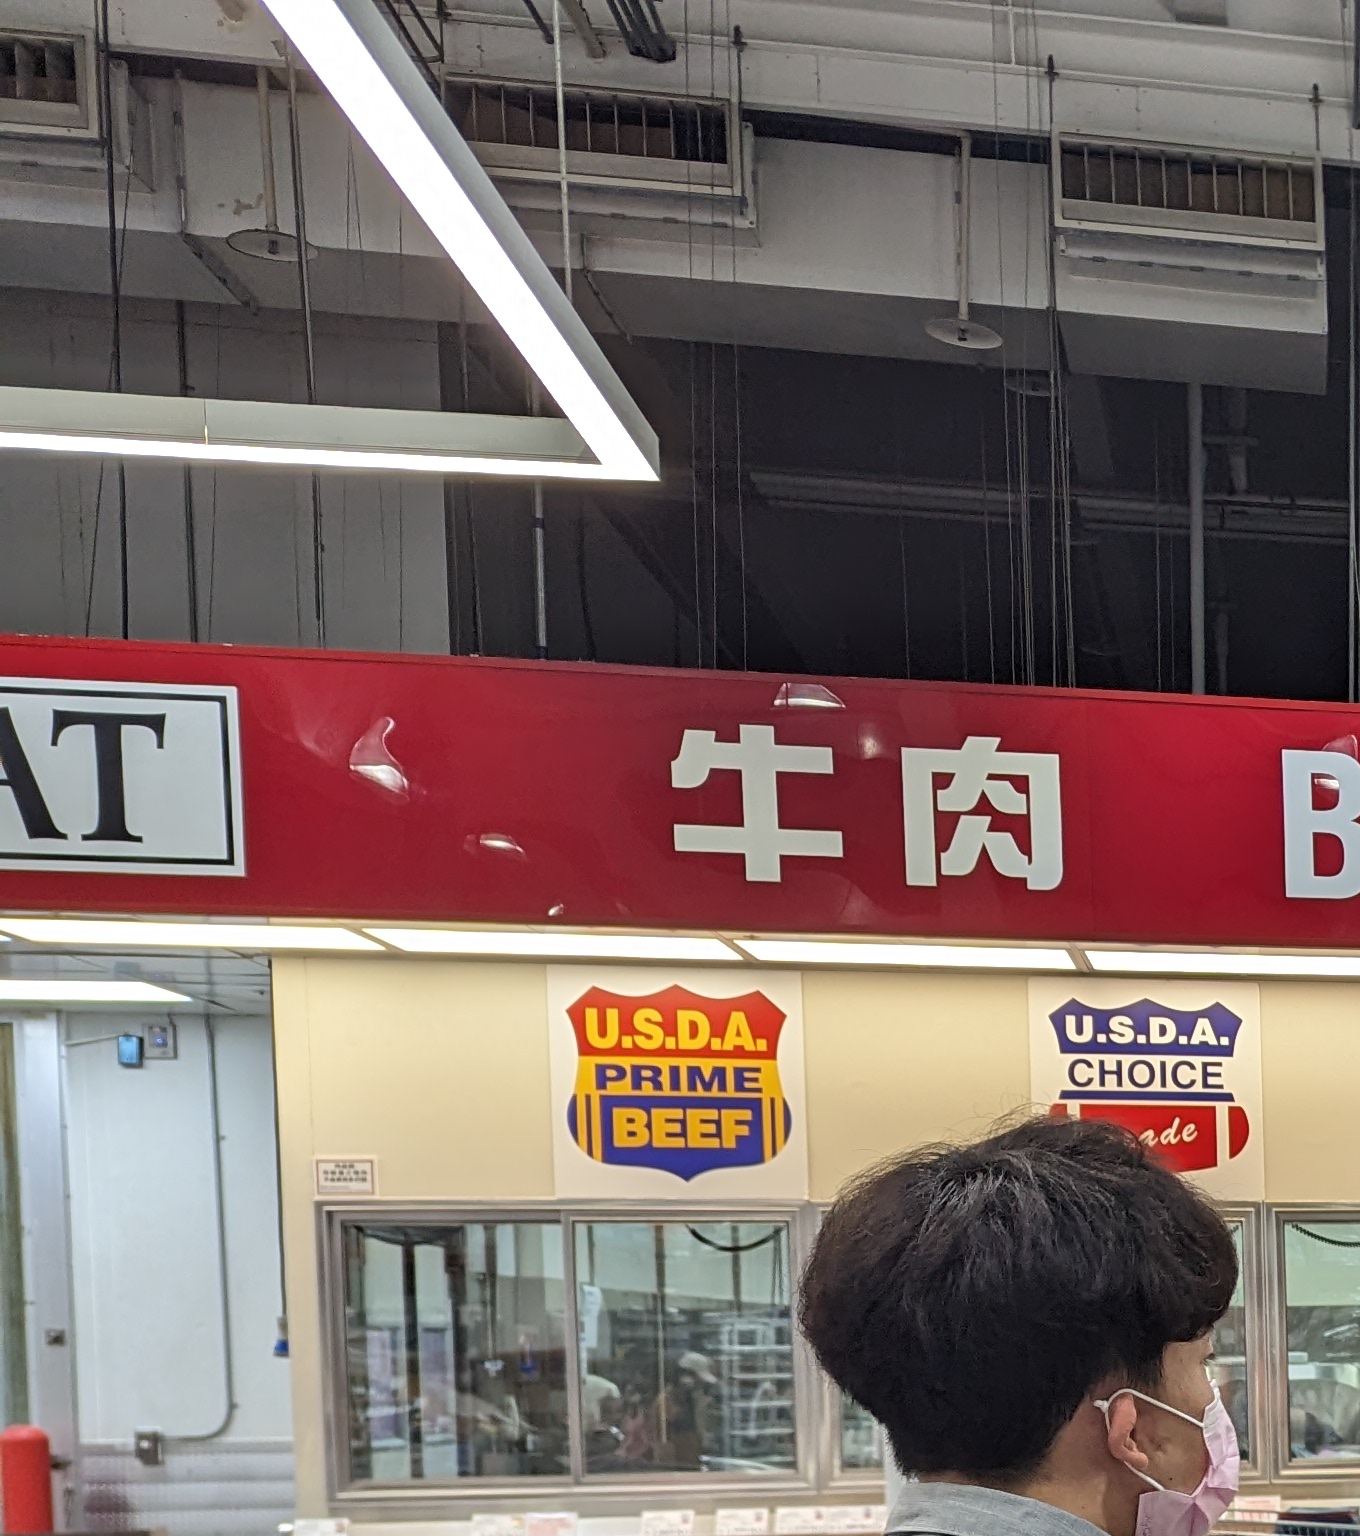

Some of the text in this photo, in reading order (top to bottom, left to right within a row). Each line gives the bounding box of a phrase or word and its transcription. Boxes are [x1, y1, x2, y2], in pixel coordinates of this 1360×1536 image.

[669, 722, 1063, 891] 牛肉
[585, 1008, 767, 1052] U.S.D.A.
[1065, 1015, 1229, 1046] U.S.D.A.
[595, 1063, 763, 1093] PRIME
[1068, 1058, 1224, 1089] CHOICE
[612, 1107, 753, 1149] BEEF
